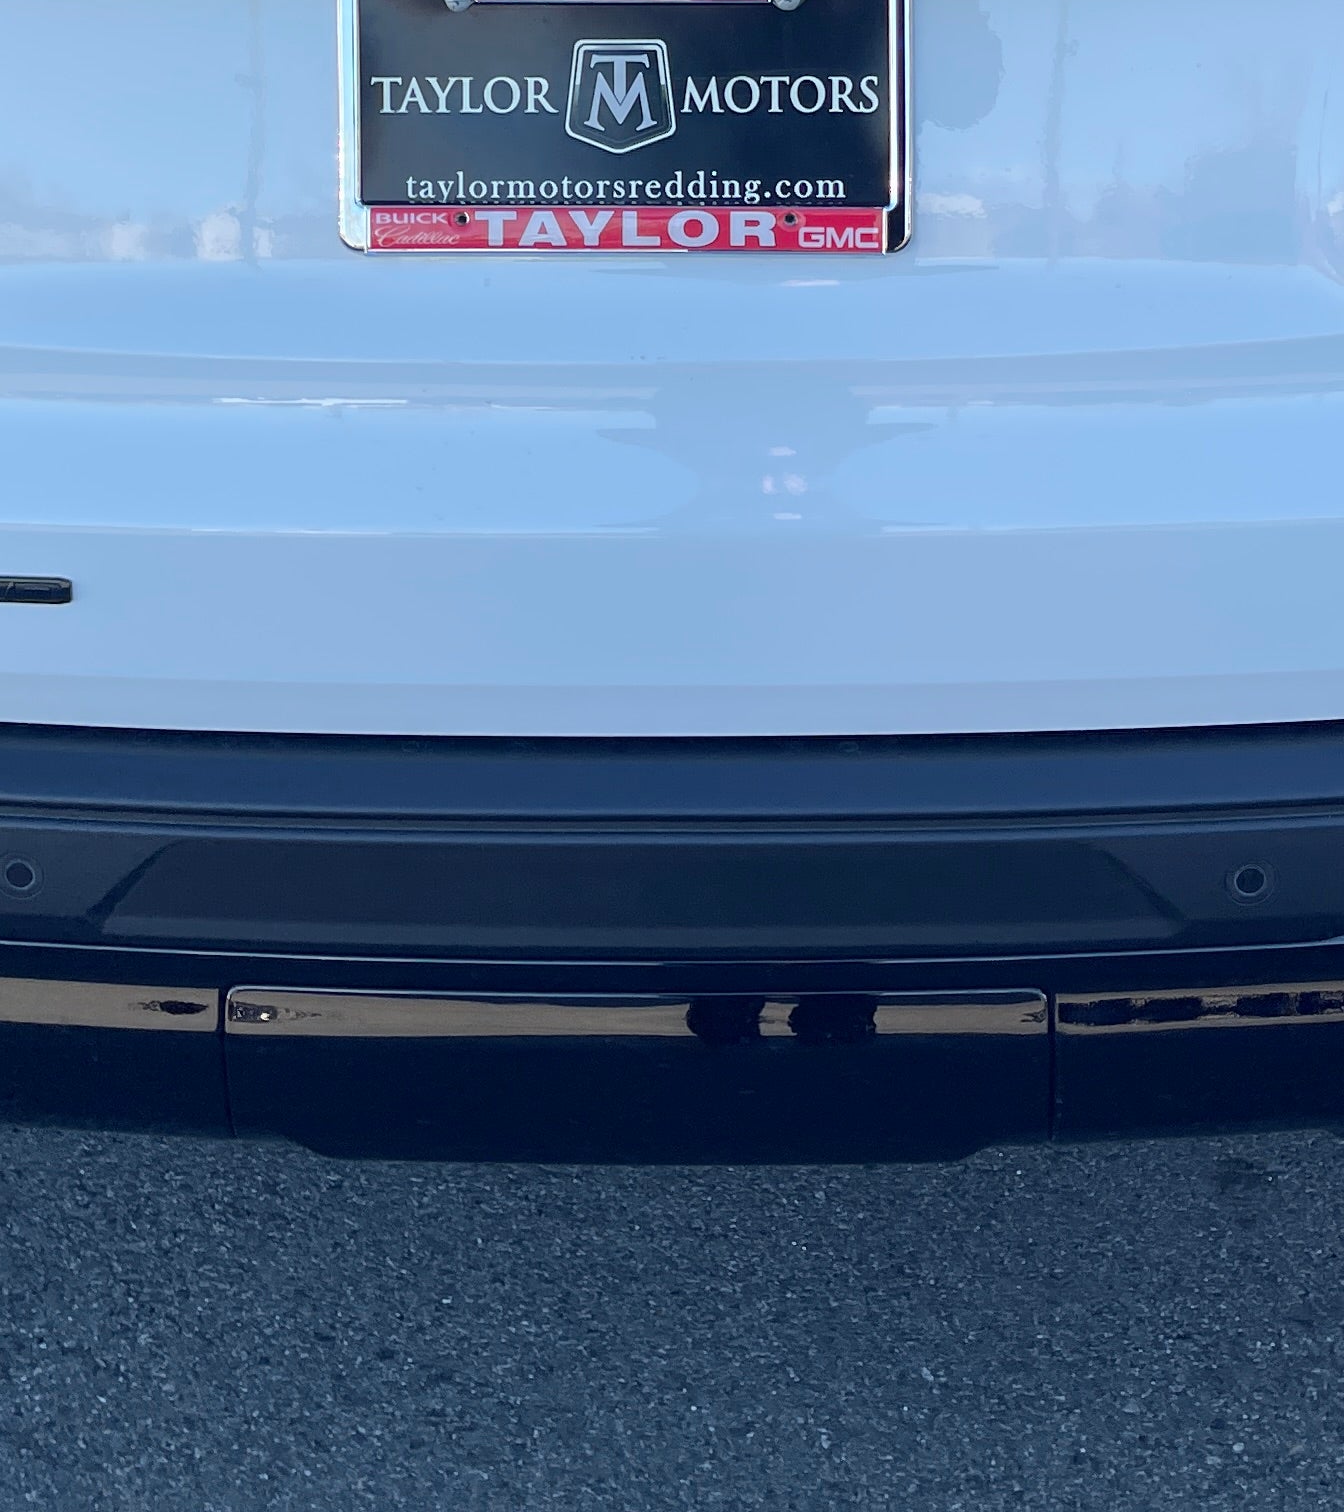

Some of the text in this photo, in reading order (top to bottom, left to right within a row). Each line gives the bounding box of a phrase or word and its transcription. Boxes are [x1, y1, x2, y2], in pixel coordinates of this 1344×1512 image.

[370, 76, 560, 115] TAYLOR
[679, 75, 880, 115] MOTORS
[405, 170, 847, 204] taylormotorsredding.com
[375, 212, 449, 225] BUICK
[474, 209, 777, 248] TAYLOR
[797, 226, 880, 250] GMC
